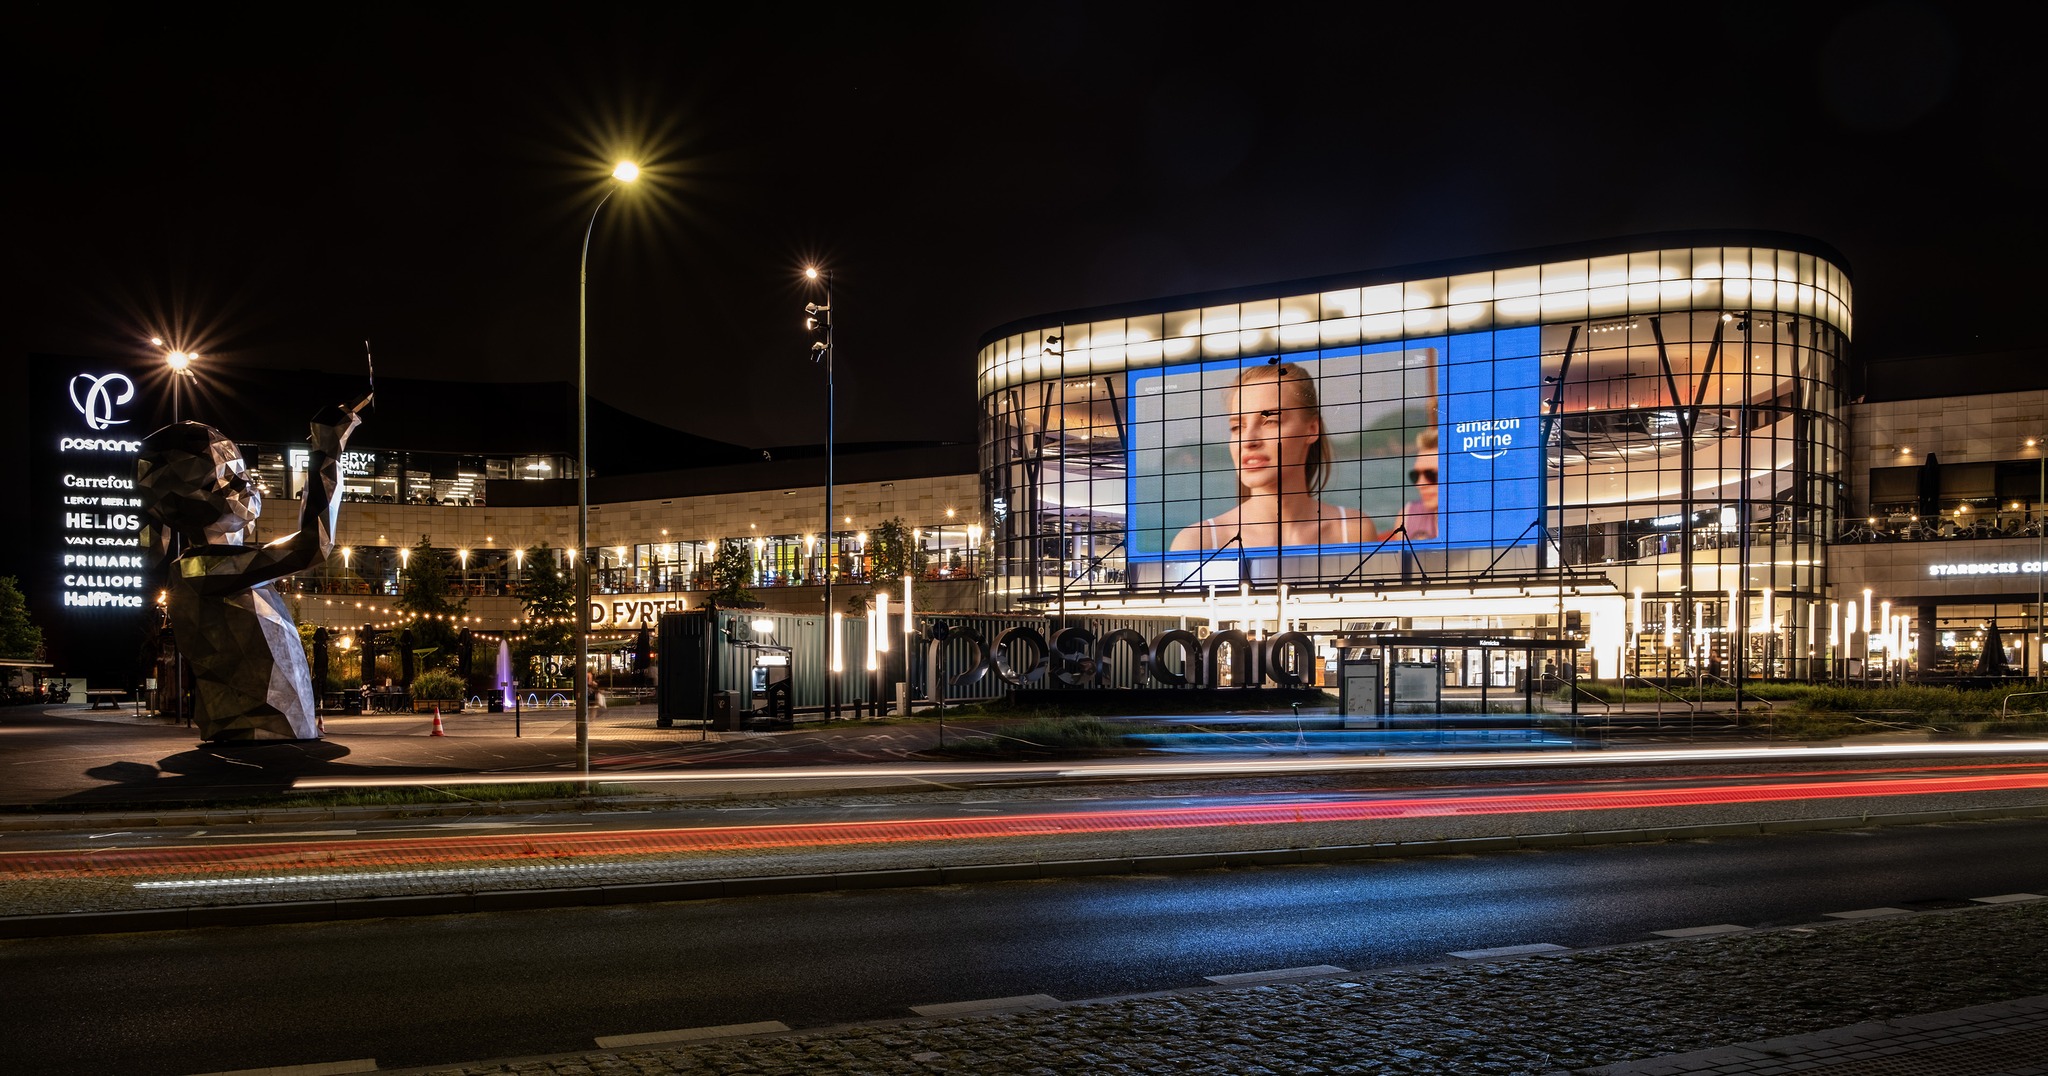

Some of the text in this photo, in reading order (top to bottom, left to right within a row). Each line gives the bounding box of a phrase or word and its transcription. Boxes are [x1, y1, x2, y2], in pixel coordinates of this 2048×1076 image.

[1456, 417, 1520, 433] amazon
[1463, 432, 1512, 452] prime
[340, 452, 376, 462] BRYK
[340, 460, 368, 471] RMY
[63, 474, 134, 489] Carrefou
[64, 496, 142, 507] LEROY MERLIN
[66, 512, 140, 531] HELIOS
[64, 536, 93, 546] VAN
[64, 554, 143, 568] PRIMARK
[1929, 562, 2018, 575] STARBUCKS
[64, 575, 142, 588] CALLIOPE
[64, 591, 143, 607] HalfPrice
[928, 626, 1317, 703] posnania
